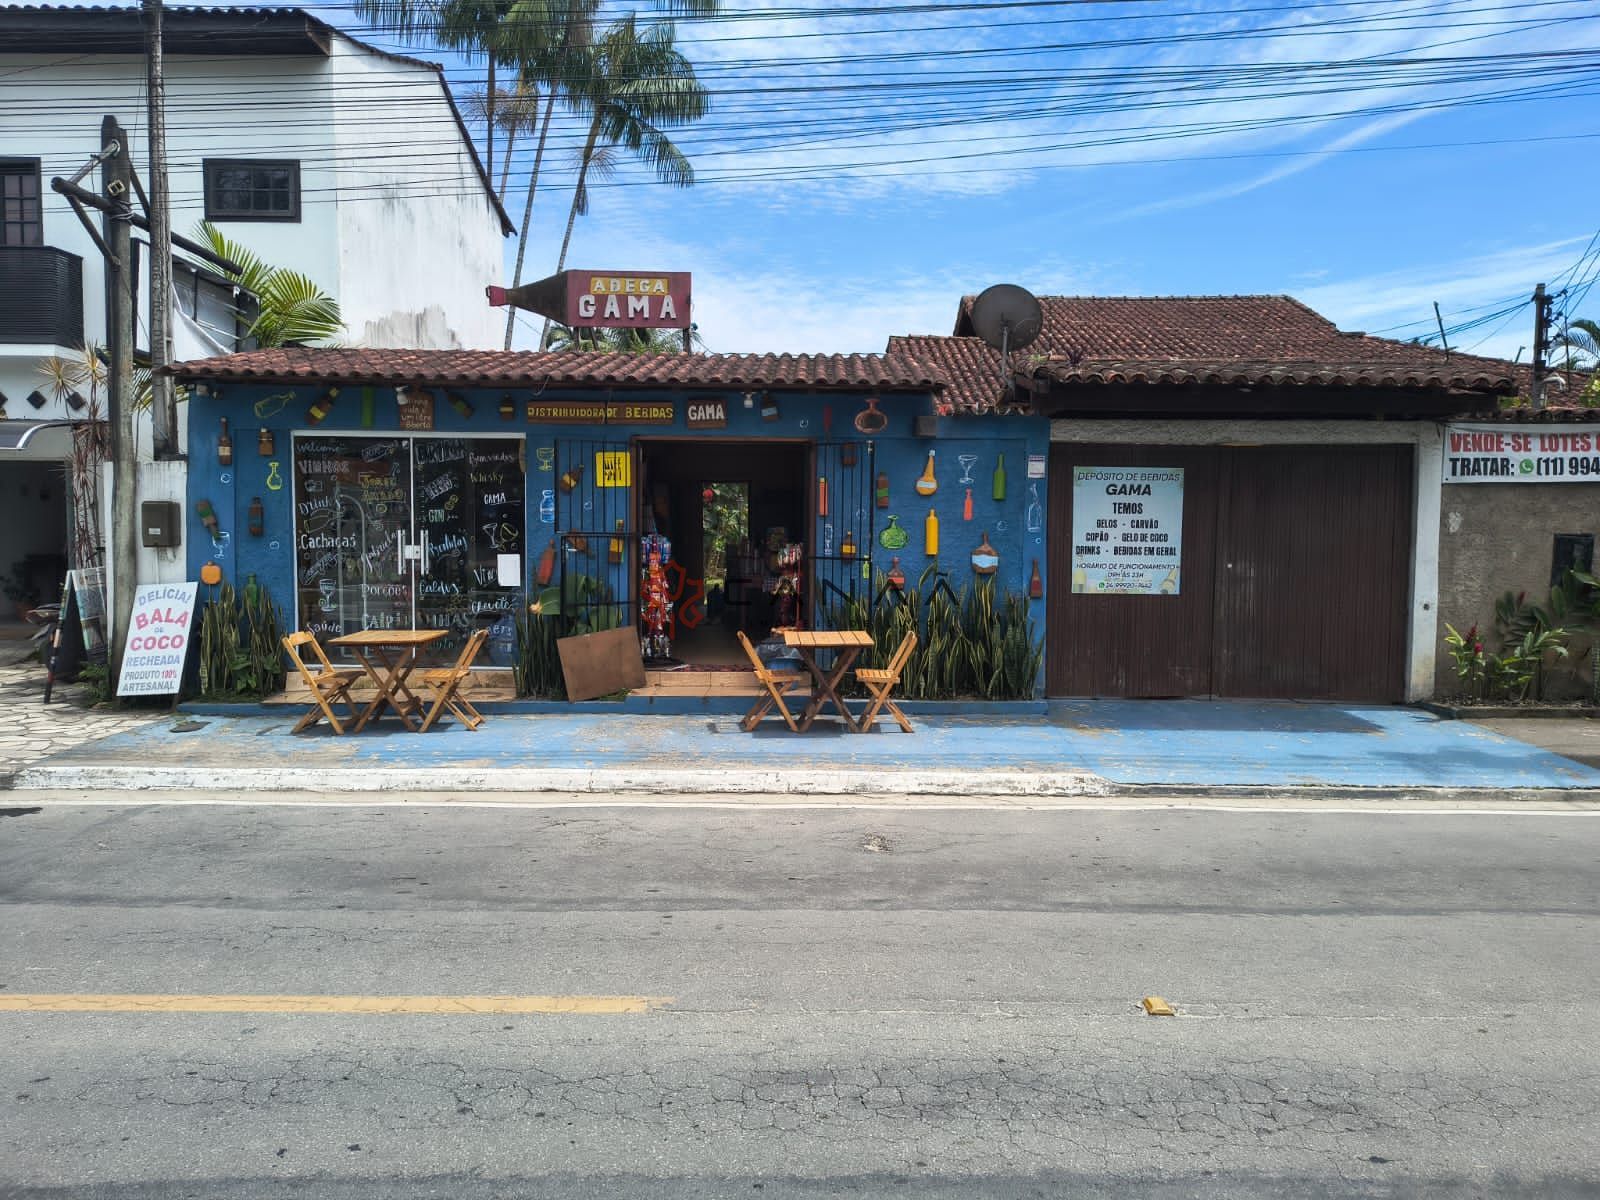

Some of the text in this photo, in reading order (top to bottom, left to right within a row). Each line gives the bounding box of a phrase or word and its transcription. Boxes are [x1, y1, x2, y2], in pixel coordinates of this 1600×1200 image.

[593, 278, 666, 293] ADEGA
[579, 294, 677, 320] GAMA
[527, 407, 605, 417] DISTRIBUIDORA
[625, 407, 673, 418] BEBIDAS
[687, 404, 725, 420] GAMA
[1450, 432, 1532, 452] VENDE-SE
[1539, 432, 1592, 452] LOTES
[1449, 457, 1515, 477] TRATAR:
[1536, 457, 1564, 476] (11)
[1078, 471, 1180, 481] DEPÓSITO DE BEBIDAS
[1105, 483, 1152, 496] GAMA
[483, 492, 506, 505] GAMA
[1112, 502, 1143, 514] TEMOS
[1096, 520, 1118, 529] GELOS
[1130, 519, 1159, 529] CARVÃO
[1085, 531, 1109, 542] COPÃO
[1121, 533, 1139, 542] GELO
[1140, 533, 1149, 542] DE
[1149, 533, 1169, 542] COCO
[1075, 546, 1101, 555] DRINKS
[1113, 546, 1143, 556] BEBIDAS
[1144, 547, 1155, 556] EM
[1155, 547, 1177, 556] GERAL
[138, 587, 192, 606] DELÍCIA!
[135, 607, 189, 630] BALA
[129, 634, 185, 651] COCO
[126, 655, 180, 667] RECHEADA
[124, 670, 160, 681] PRODUTO
[121, 681, 175, 692] ARTESANAL
